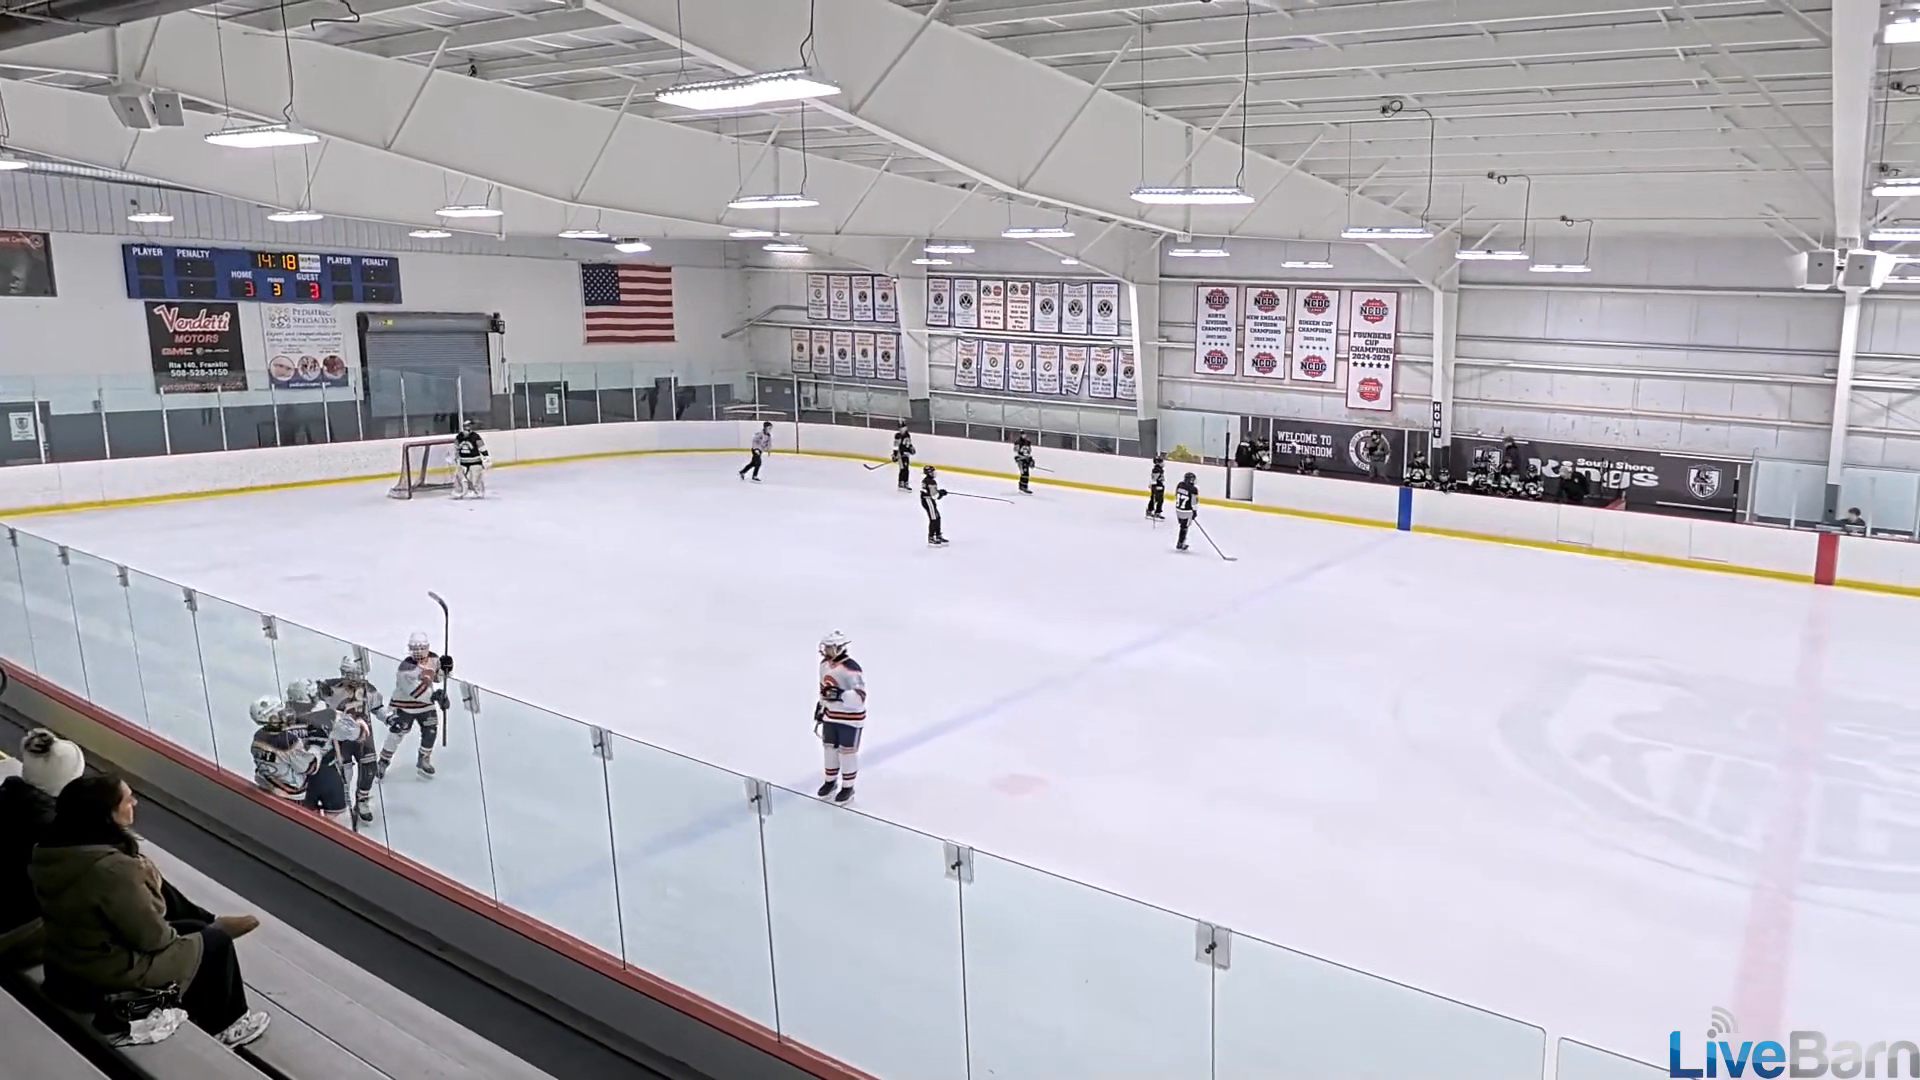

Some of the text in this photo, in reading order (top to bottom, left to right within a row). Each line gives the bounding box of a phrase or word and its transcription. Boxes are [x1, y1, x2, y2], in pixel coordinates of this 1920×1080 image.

[132, 247, 163, 256] PLAYER
[176, 249, 210, 258] PENALTY
[257, 253, 297, 270] 14:18
[327, 256, 352, 264] PLAYER
[361, 258, 389, 266] PENALTY
[231, 271, 253, 279] HOME
[296, 273, 319, 281] GUEST
[245, 281, 254, 296] 3
[273, 283, 281, 296] 3
[309, 282, 319, 298] 3
[1205, 296, 1230, 304] NCDC
[1254, 297, 1280, 306] NCDC
[1304, 299, 1330, 308] NCDC
[1360, 306, 1389, 316] NCDC
[153, 305, 231, 332] Vendetti
[174, 334, 220, 344] MOTORS
[161, 347, 194, 356] GMC
[1350, 346, 1393, 354] CHAMPIONS
[1204, 356, 1228, 365] NCDC
[1352, 353, 1391, 361] 2024-2025
[1252, 358, 1277, 368] NCDC
[1300, 362, 1327, 371] NCDC
[1277, 431, 1332, 445] WELCOME TO
[1275, 443, 1333, 458] THE KINGDOM
[1615, 461, 1655, 472] Shore
